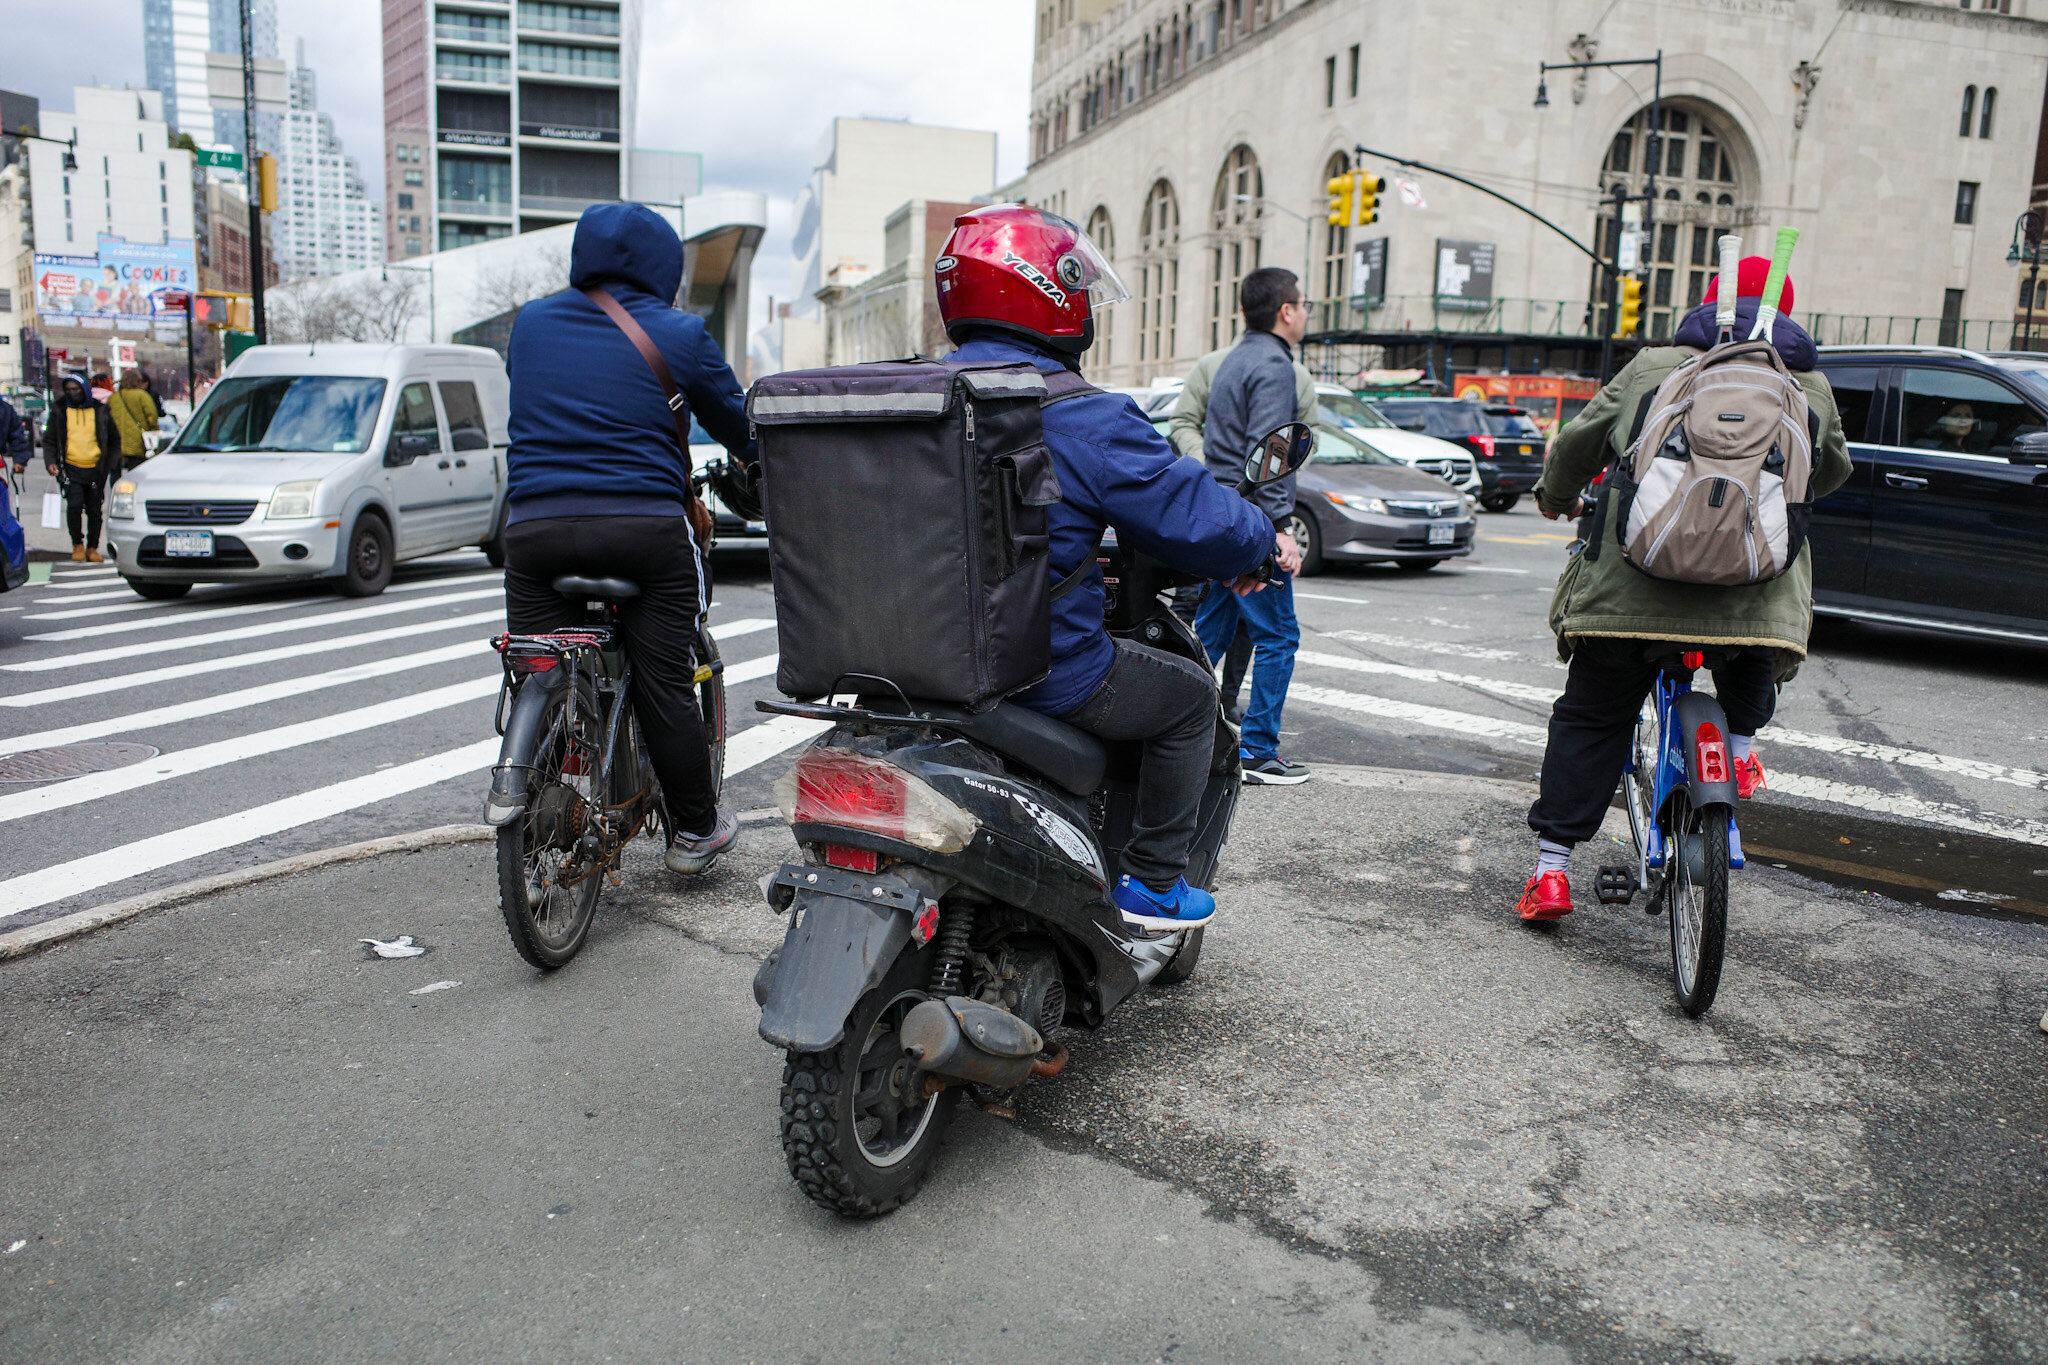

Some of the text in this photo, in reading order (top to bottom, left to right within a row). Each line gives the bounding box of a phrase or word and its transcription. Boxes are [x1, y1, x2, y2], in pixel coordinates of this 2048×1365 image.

[210, 152, 218, 166] 4
[936, 258, 953, 270] YEMA
[1002, 251, 1066, 307] YEMA
[963, 776, 1009, 798] Gator 50-S3
[1043, 814, 1090, 865] EXPRESS
